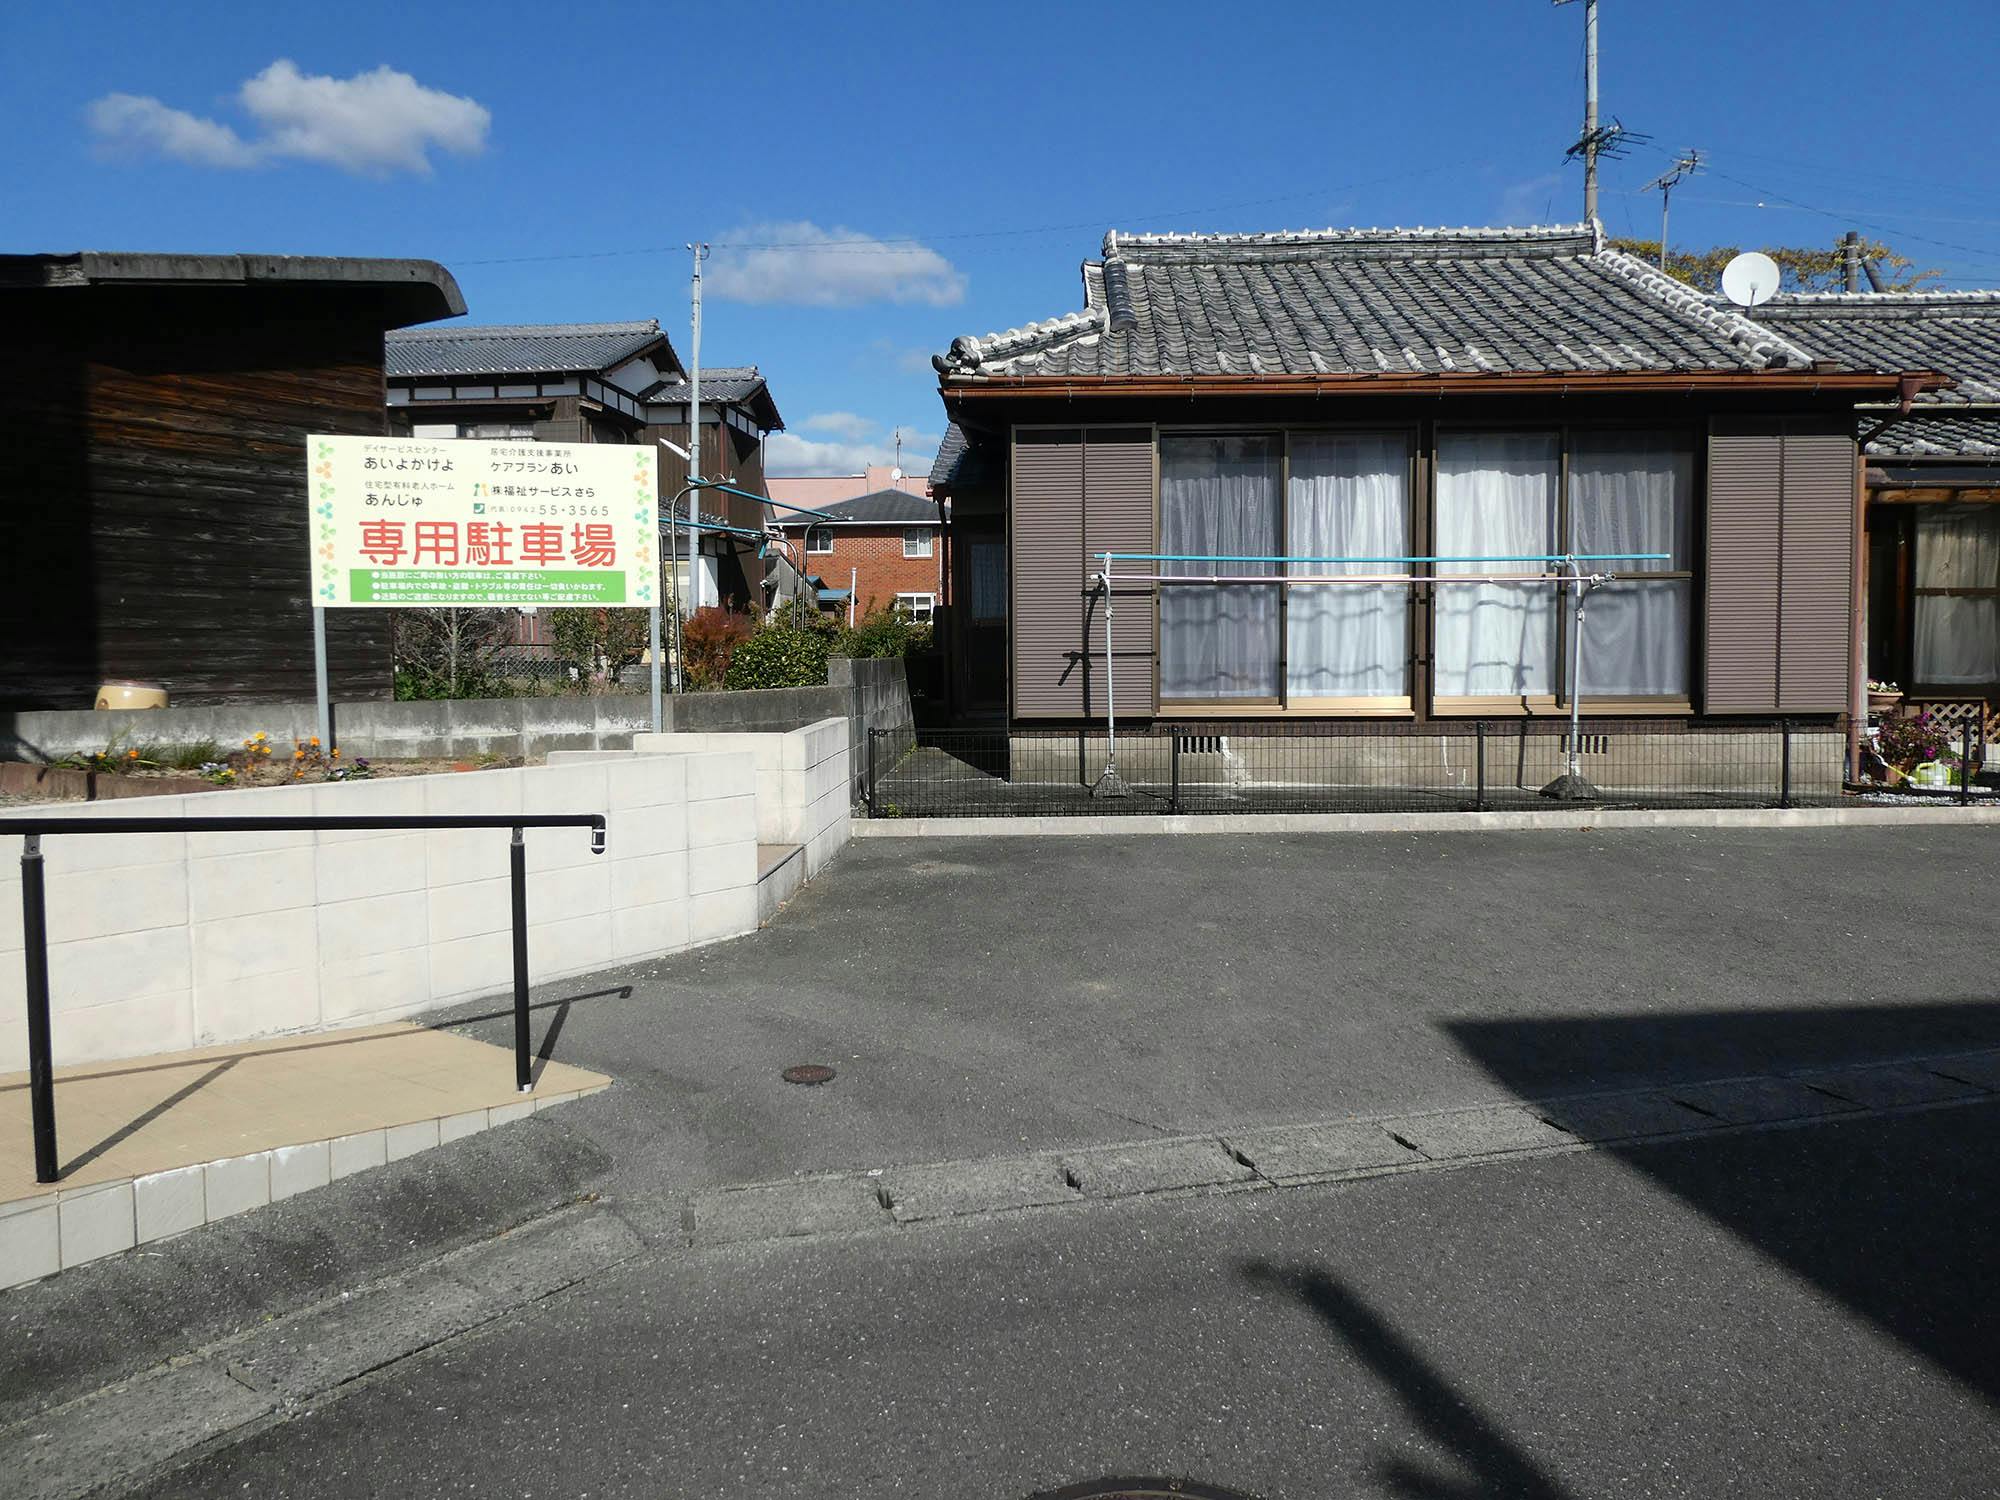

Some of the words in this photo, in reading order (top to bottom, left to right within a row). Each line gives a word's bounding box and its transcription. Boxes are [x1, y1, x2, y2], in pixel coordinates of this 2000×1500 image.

[364, 445, 447, 454] デイサービスセンター
[363, 456, 454, 472] あいよかけよ
[364, 493, 423, 508] あんじゅ
[359, 519, 617, 567] 専用駐車場
